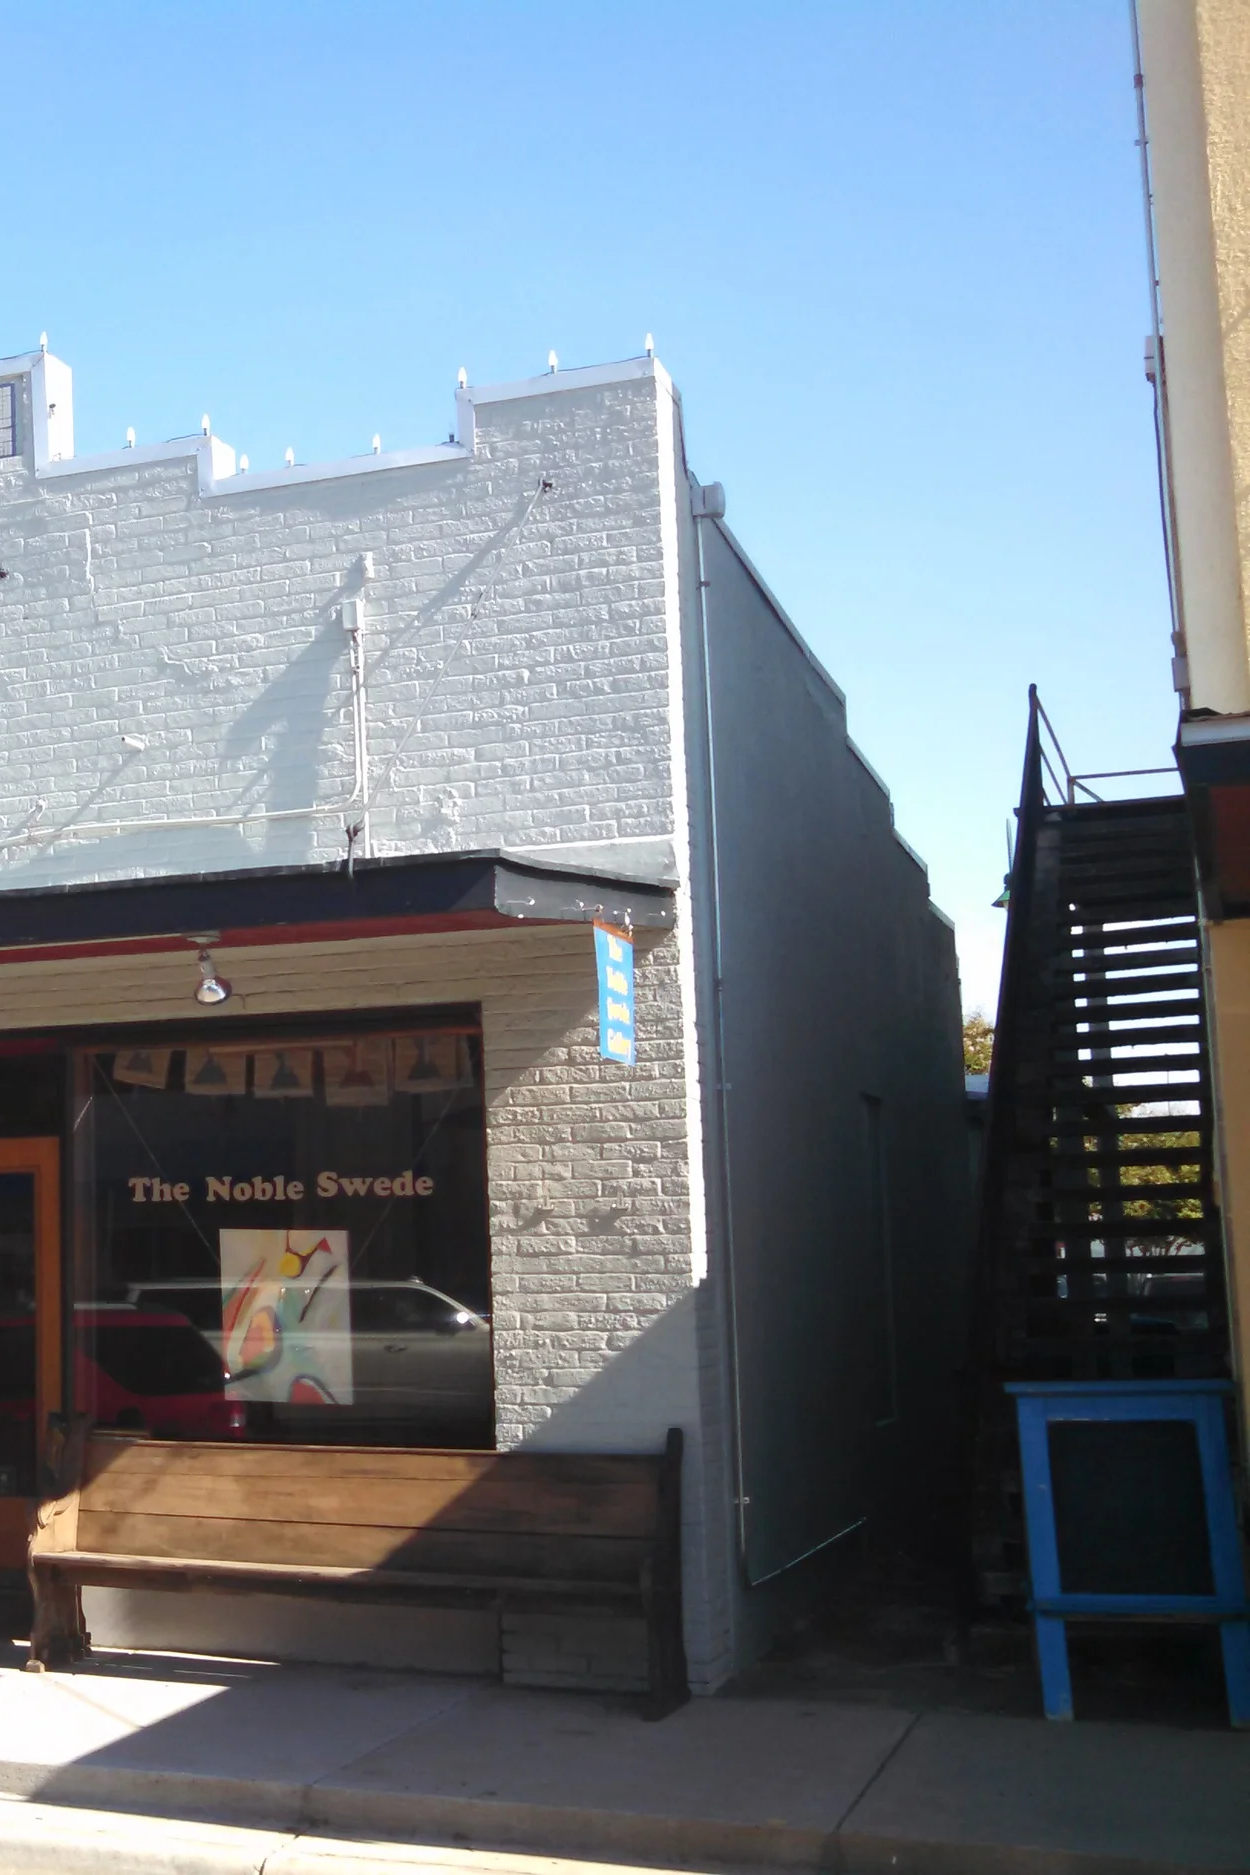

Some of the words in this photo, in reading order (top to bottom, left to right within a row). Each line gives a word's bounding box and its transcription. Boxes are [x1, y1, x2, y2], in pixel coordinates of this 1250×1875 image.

[128, 1176, 190, 1202] The
[205, 1175, 305, 1201] Noble
[316, 1169, 435, 1198] Swede
